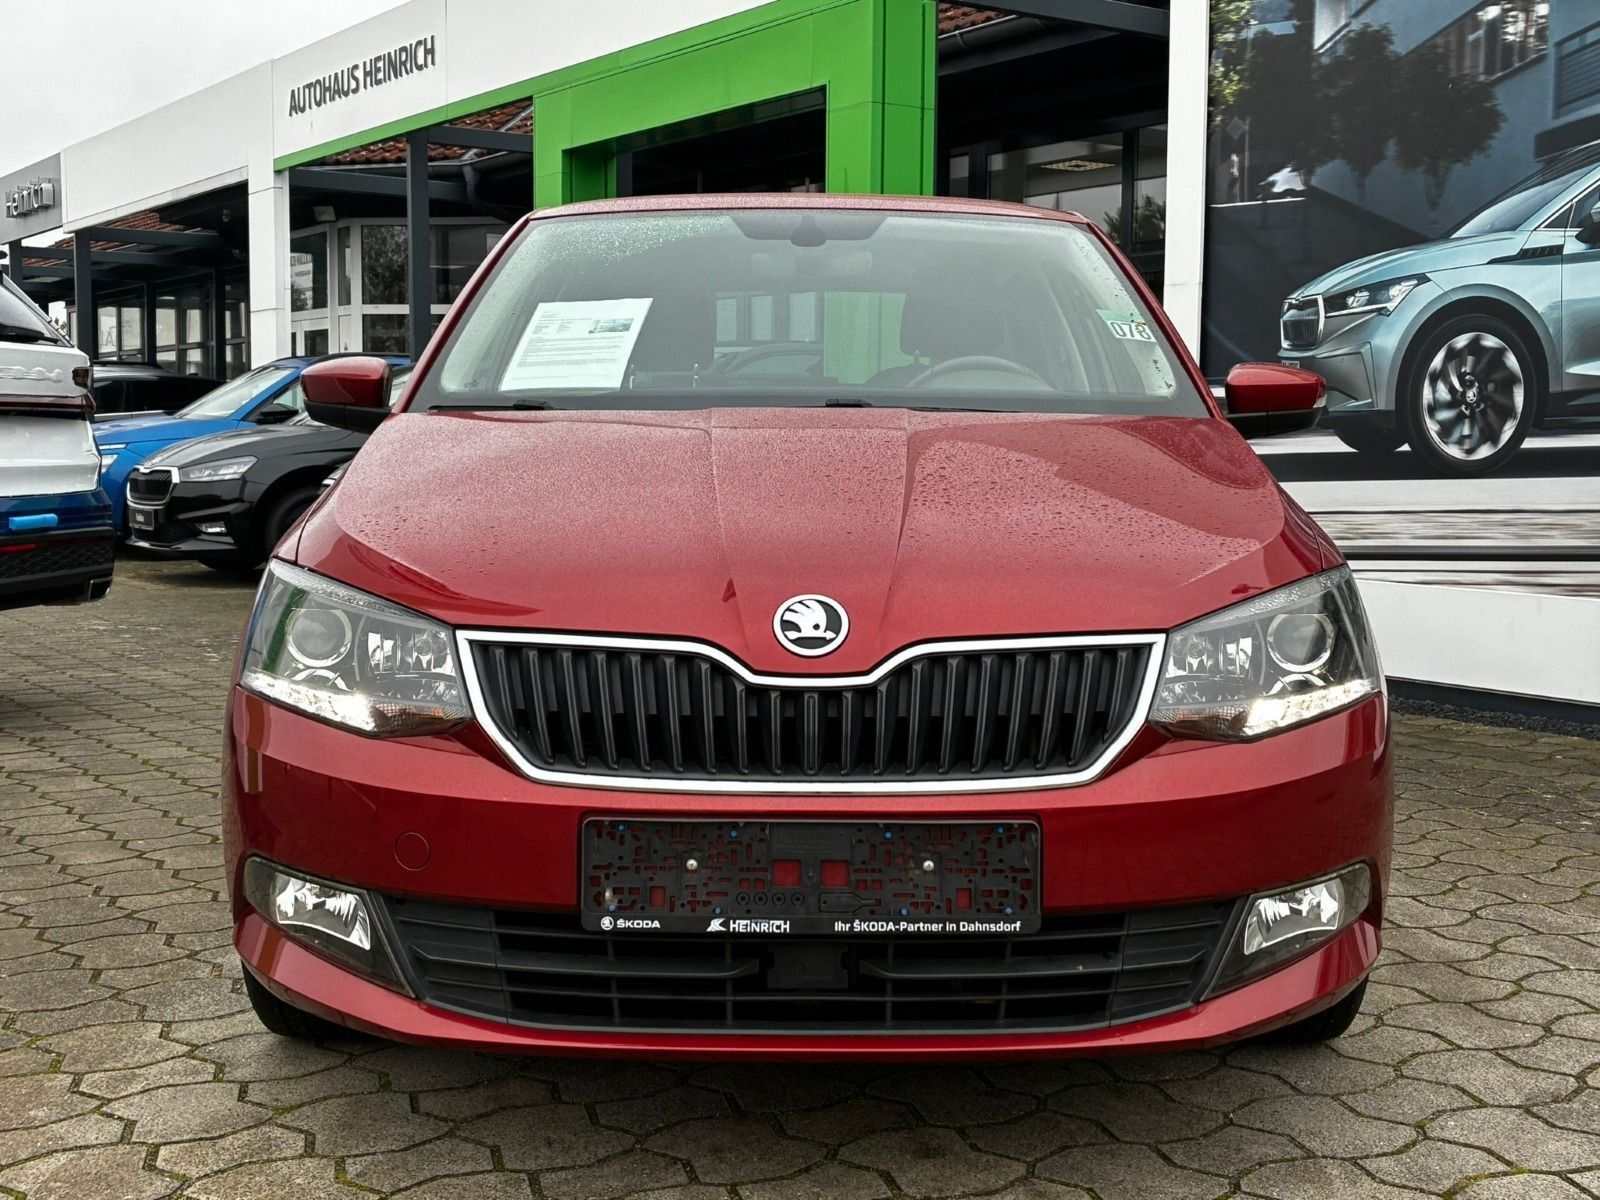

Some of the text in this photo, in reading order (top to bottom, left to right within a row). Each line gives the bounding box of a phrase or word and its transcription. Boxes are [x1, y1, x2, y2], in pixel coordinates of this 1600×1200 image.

[289, 34, 436, 117] AUTOHAUS HEINRICH
[616, 918, 661, 929] ŠKODA
[729, 919, 790, 933] HEINRICH
[834, 919, 1022, 932] Ihr ŠKODA-Partner in Dahnsdorf
